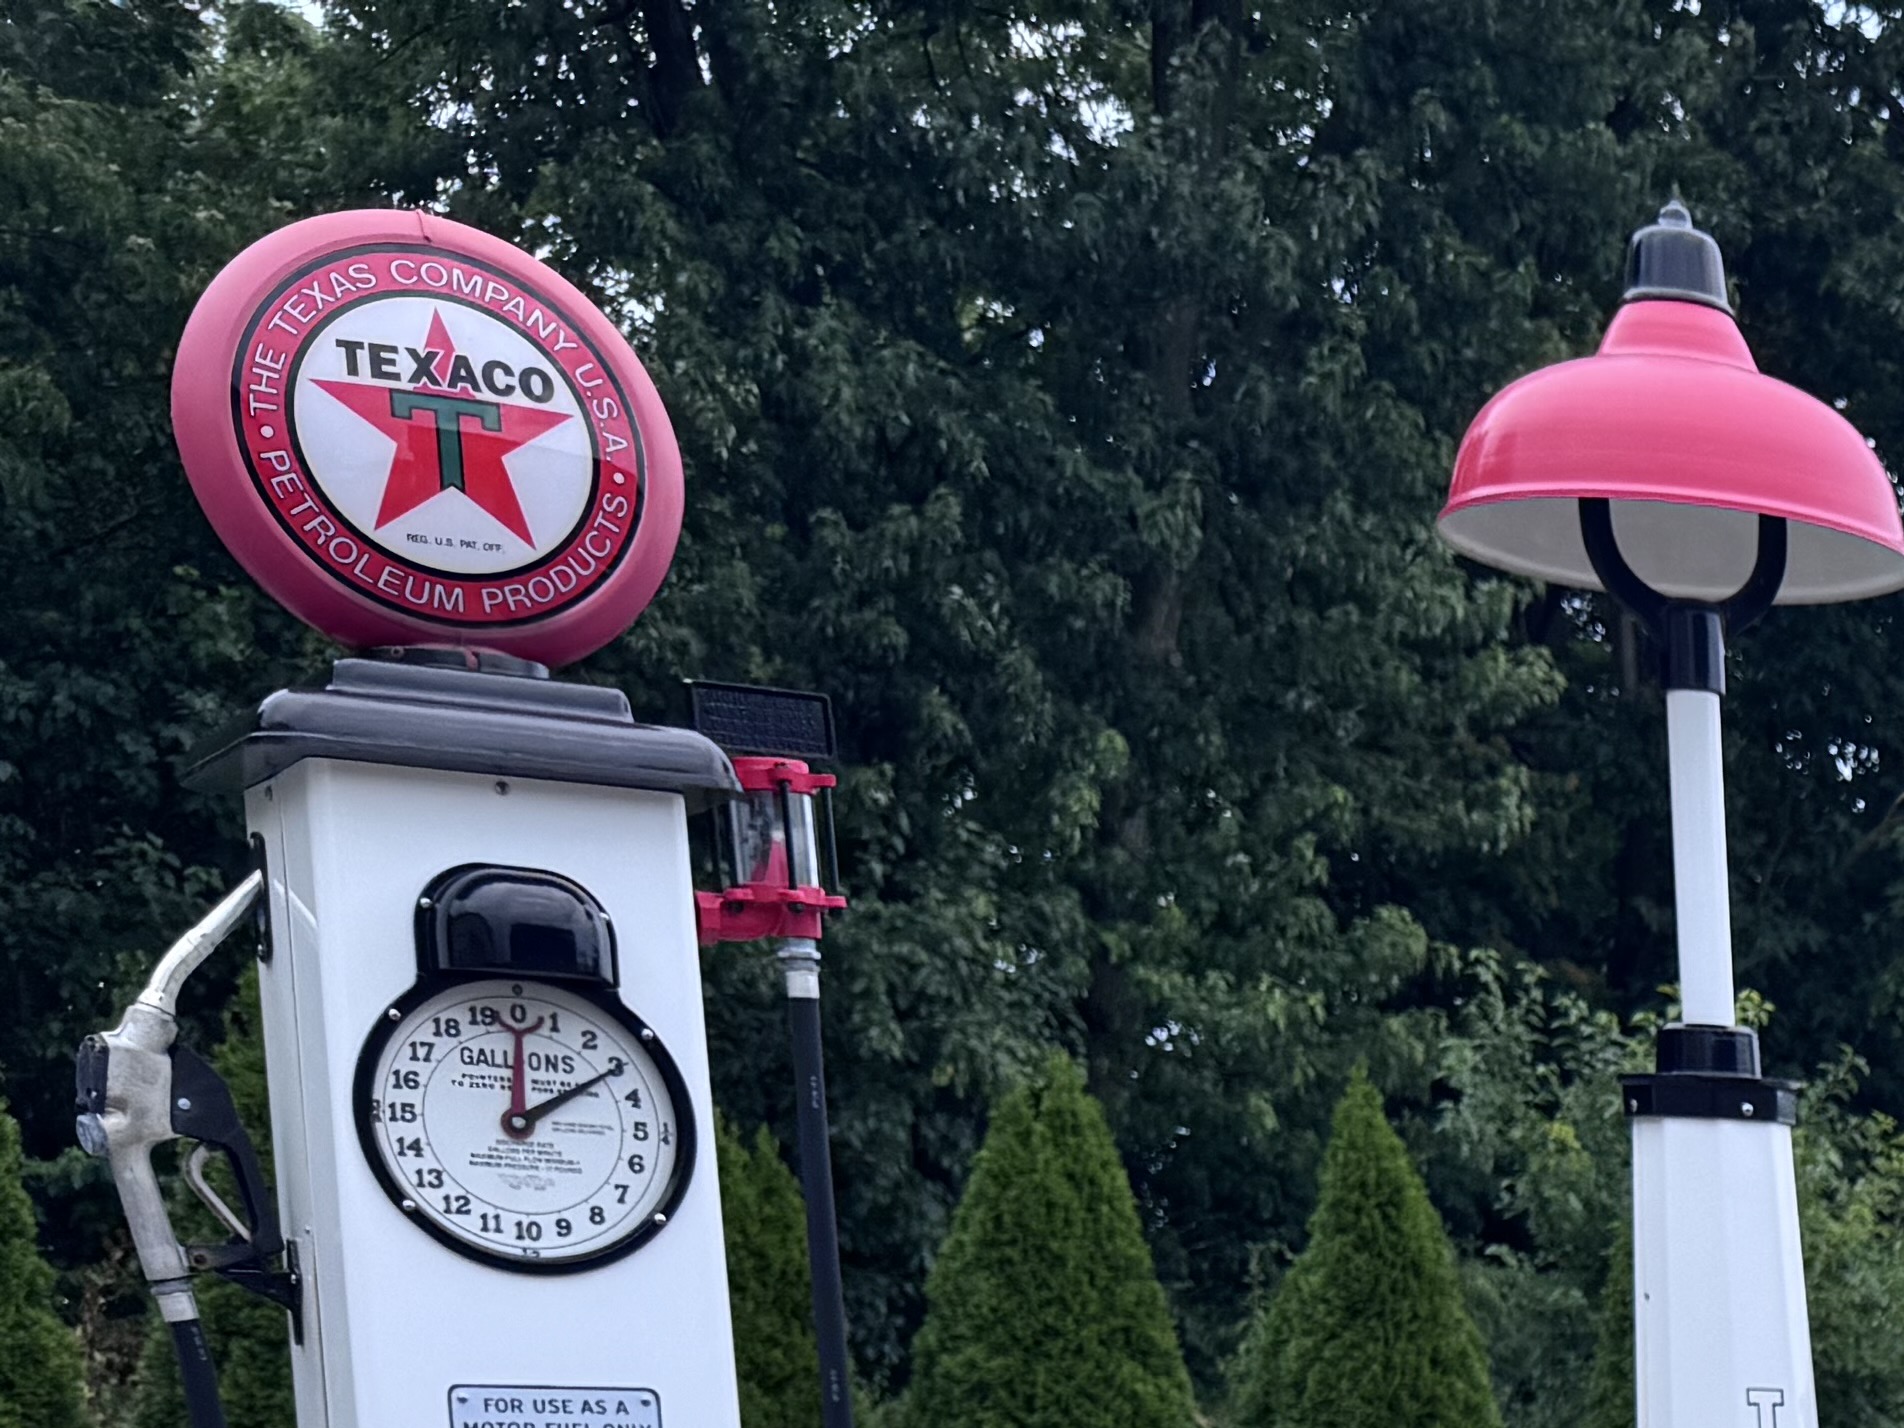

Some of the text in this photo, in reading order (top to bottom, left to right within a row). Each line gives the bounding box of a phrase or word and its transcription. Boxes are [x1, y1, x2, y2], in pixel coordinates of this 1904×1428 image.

[249, 342, 285, 417] THE
[269, 262, 377, 337] TEXAS
[389, 259, 578, 354] COMPANY
[335, 337, 555, 404] TEXACO
[259, 448, 629, 615] PETROLEUM PRODUCTS
[510, 1003, 526, 1024] 0
[549, 1012, 561, 1033] 1
[432, 1017, 461, 1038] 18
[581, 1030, 598, 1051] 2
[408, 1042, 436, 1063] 17
[391, 1070, 420, 1091] 16
[624, 1088, 642, 1109] 4
[388, 1103, 418, 1123] 15
[632, 1121, 649, 1142] 5
[396, 1137, 425, 1158] 14
[628, 1154, 645, 1175] 6
[415, 1168, 445, 1189] 13
[614, 1184, 630, 1204] 7
[442, 1195, 472, 1216] 12
[589, 1205, 605, 1226] 8
[480, 1213, 505, 1234] 11
[515, 1221, 542, 1242] 10
[555, 1217, 573, 1237] 9
[483, 1397, 630, 1415] FOR USE AS A
